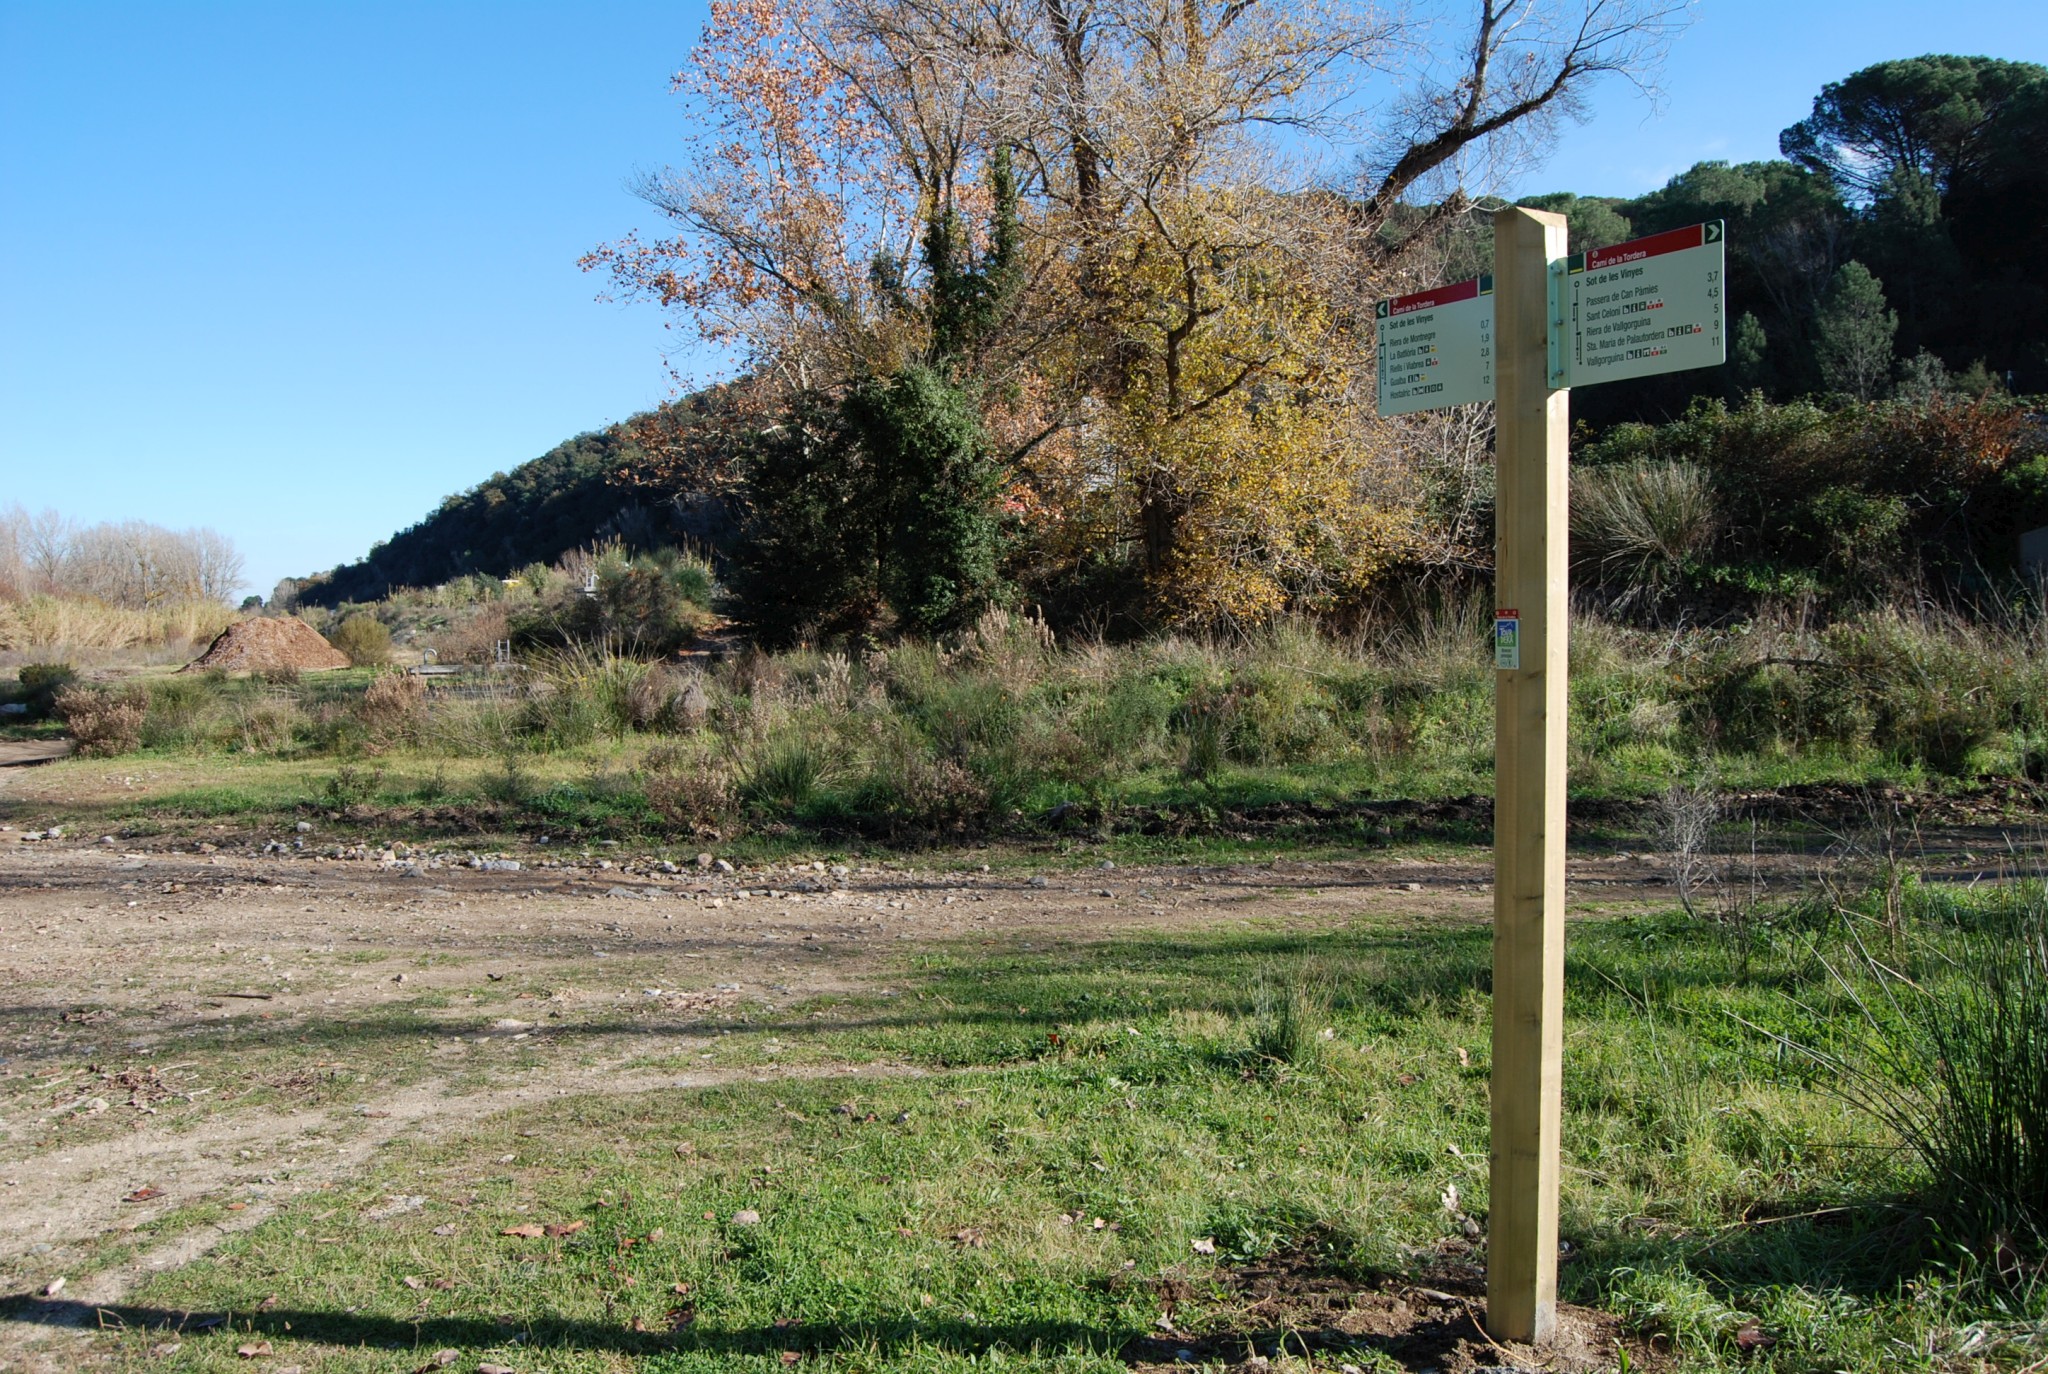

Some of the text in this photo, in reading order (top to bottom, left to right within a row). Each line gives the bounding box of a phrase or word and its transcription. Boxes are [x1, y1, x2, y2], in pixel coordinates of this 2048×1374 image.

[1608, 257, 1616, 265] de
[1617, 255, 1623, 263] la
[1624, 250, 1647, 261] Tordera
[1586, 267, 1644, 286] Sot de les Vinyes
[1707, 270, 1719, 283] 3,7
[1586, 294, 1610, 307] Passera
[1611, 292, 1620, 302] de
[1621, 289, 1633, 300] Can
[1707, 287, 1719, 299] 4,5
[1405, 303, 1411, 312] de
[1417, 300, 1435, 309] Tordera
[1713, 303, 1719, 313] 5
[1586, 305, 1621, 322] Sant Celoni
[1390, 314, 1434, 330] Sot de les Vinyes
[1480, 319, 1489, 330] 0,7
[1586, 317, 1651, 337] Riera de Vallgorguina
[1713, 320, 1719, 330] 9
[1390, 331, 1436, 347] Riera de Montnegre
[1586, 330, 1665, 352] Sta. Maria de Palautordera
[1711, 336, 1719, 346] 11
[1390, 352, 1396, 361] La
[1586, 353, 1625, 367] Vallgorguina
[1485, 361, 1490, 370] 7
[1483, 375, 1490, 385] 12
